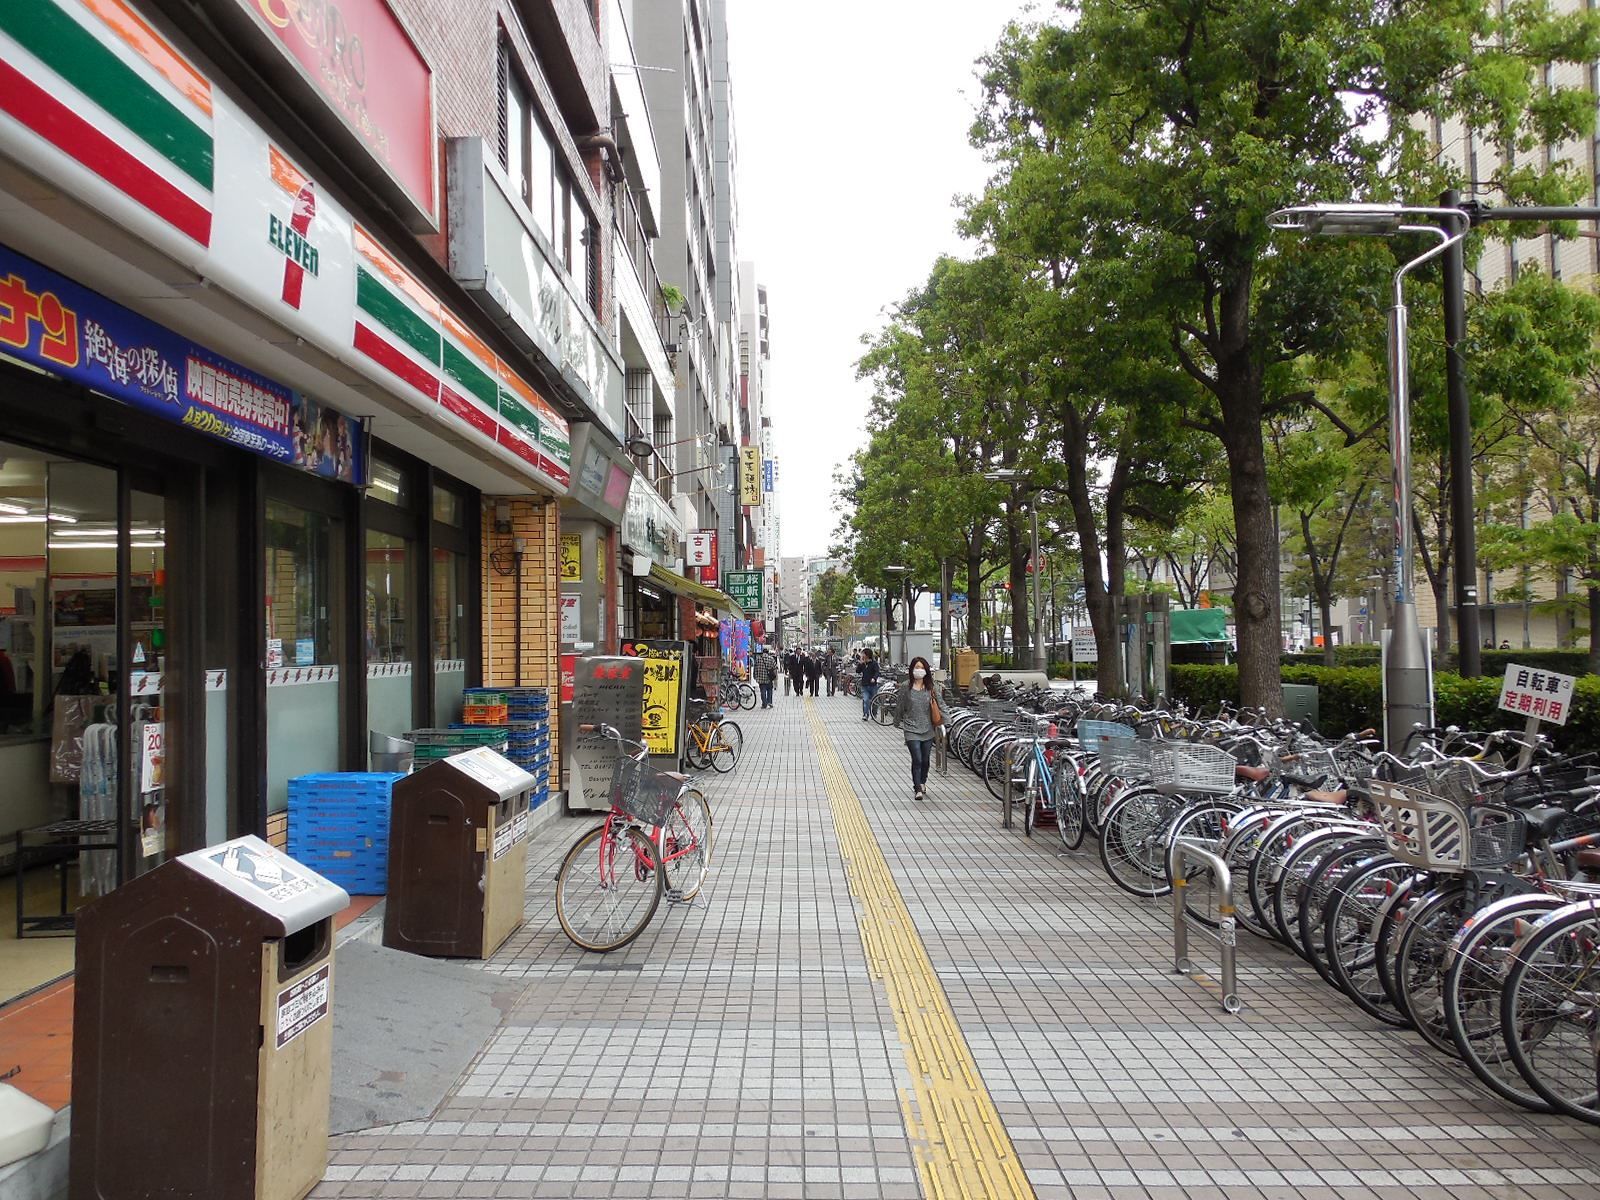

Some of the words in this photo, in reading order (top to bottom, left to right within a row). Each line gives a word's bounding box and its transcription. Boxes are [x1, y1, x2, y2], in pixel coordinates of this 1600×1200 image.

[85, 320, 183, 407] 絶海の探偵
[1516, 670, 1561, 694] 自転車
[1504, 690, 1563, 720] 定期利用
